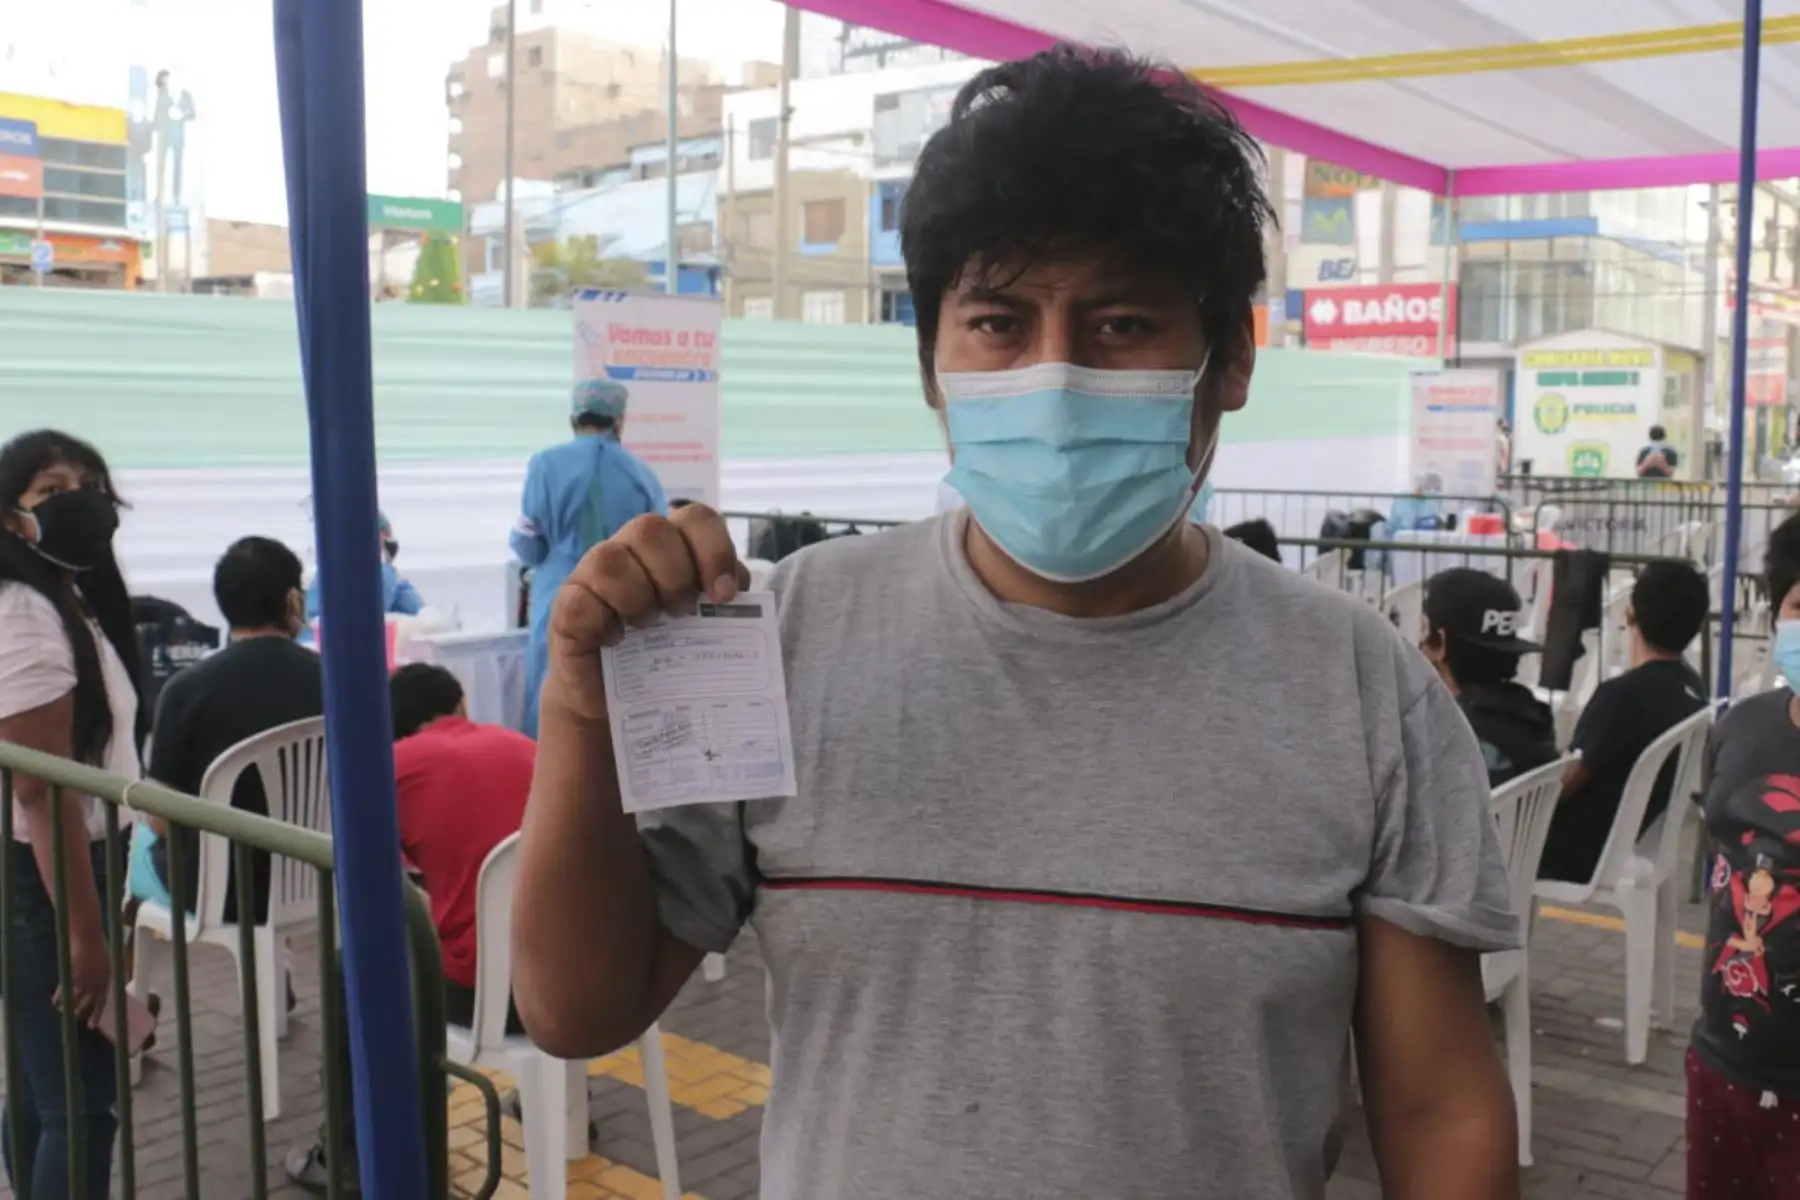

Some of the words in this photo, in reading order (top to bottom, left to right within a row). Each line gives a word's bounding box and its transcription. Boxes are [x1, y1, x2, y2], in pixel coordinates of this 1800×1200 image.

[1342, 293, 1442, 324] BAÑOS
[607, 322, 672, 346] Vamos
[694, 330, 715, 348] tu
